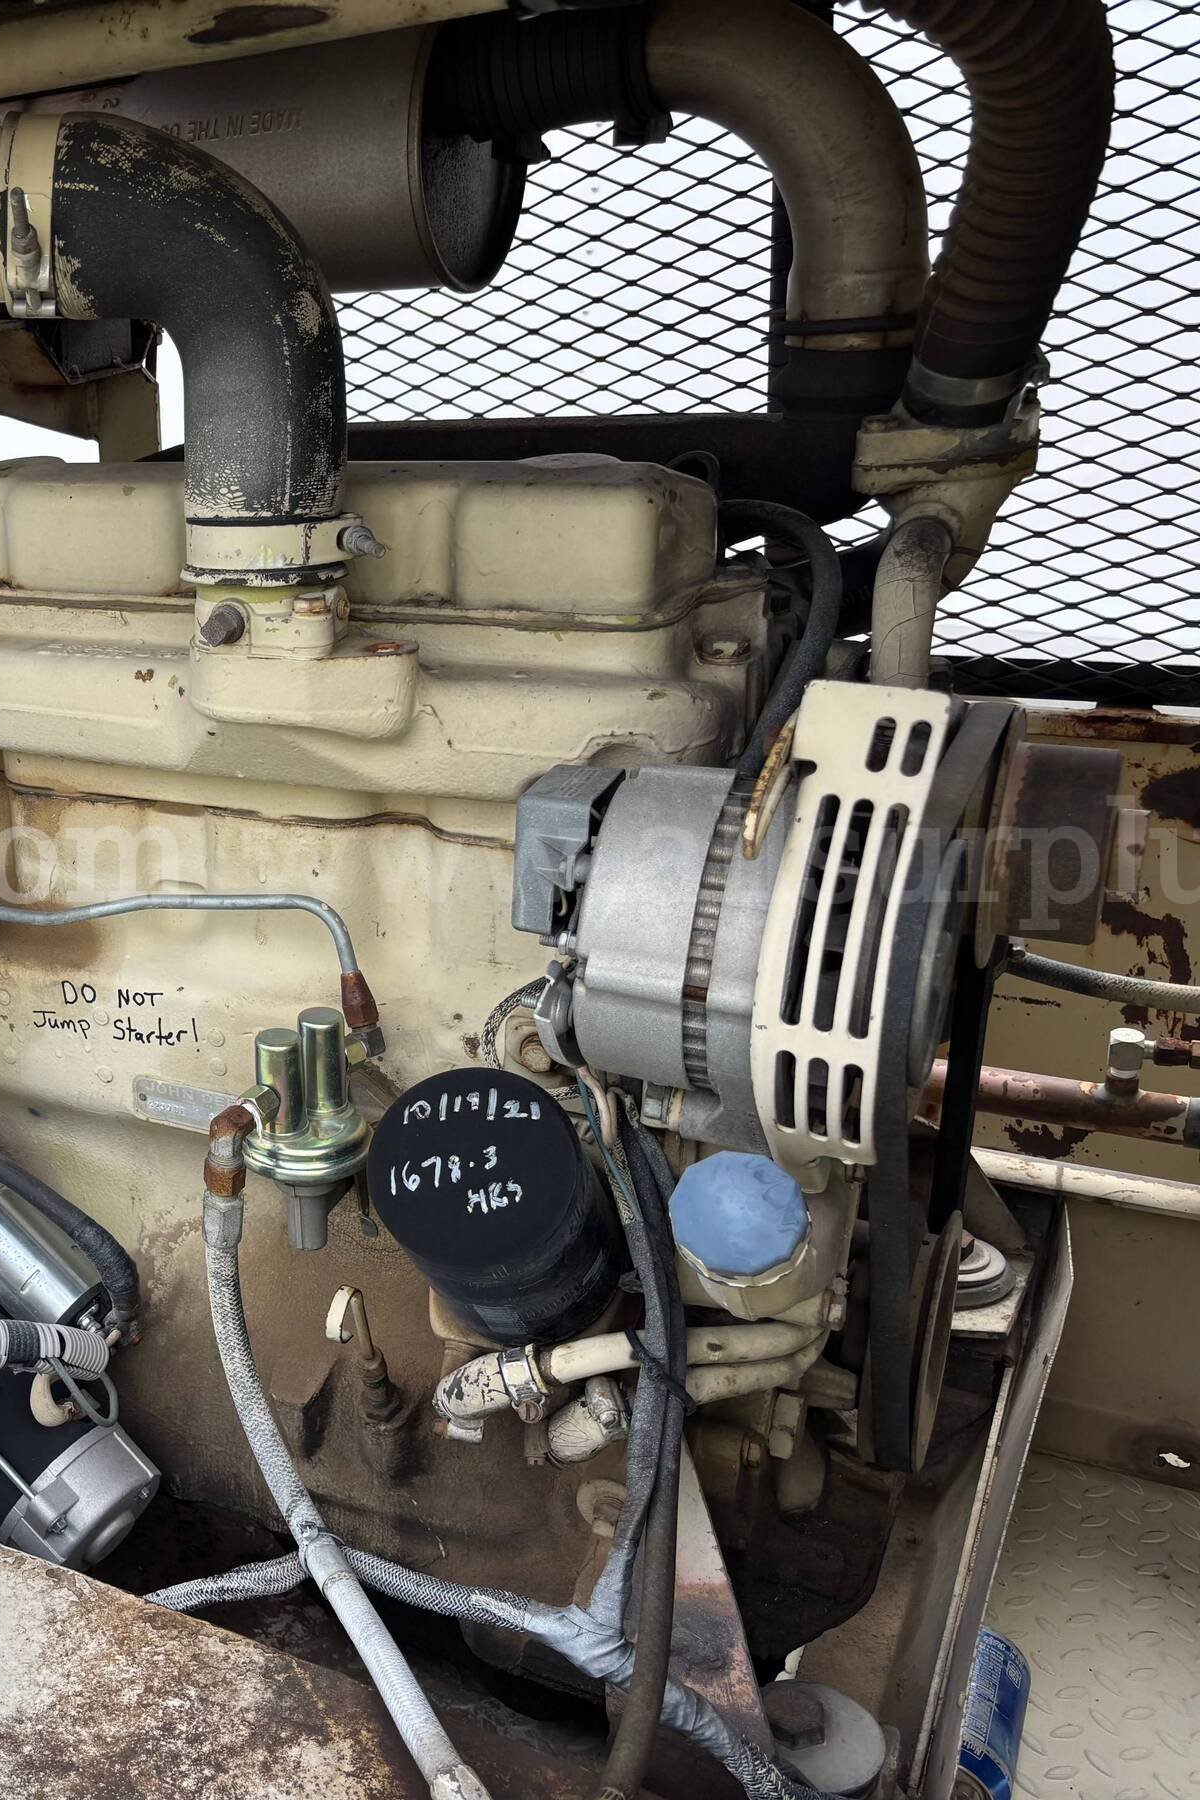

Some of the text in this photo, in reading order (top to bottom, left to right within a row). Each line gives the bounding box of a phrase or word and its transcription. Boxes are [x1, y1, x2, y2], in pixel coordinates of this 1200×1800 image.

[188, 119, 219, 143] THE
[224, 114, 245, 140] IN
[61, 980, 164, 1008] DO NOT
[32, 1010, 200, 1052] Jump Starter!
[145, 1079, 194, 1101] JOHN
[402, 1087, 541, 1125] 10/19/21
[390, 1145, 498, 1196] 1678.3
